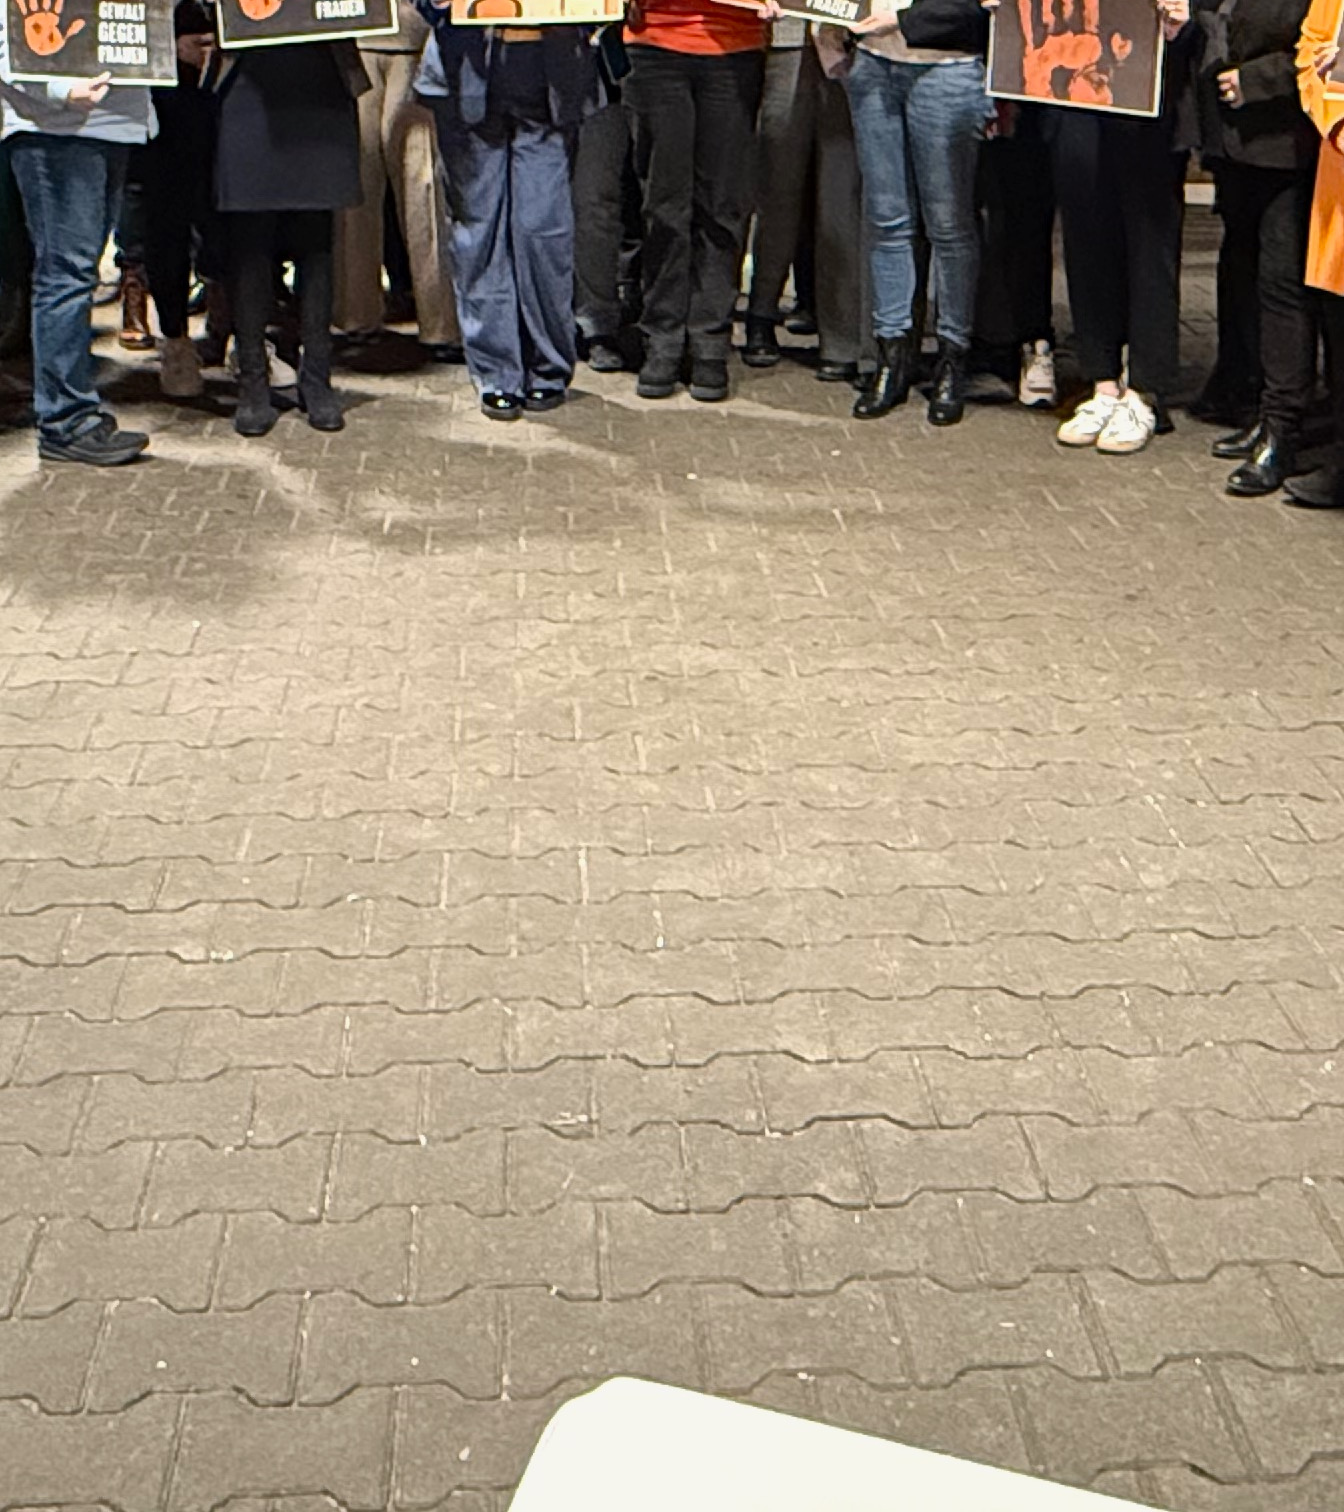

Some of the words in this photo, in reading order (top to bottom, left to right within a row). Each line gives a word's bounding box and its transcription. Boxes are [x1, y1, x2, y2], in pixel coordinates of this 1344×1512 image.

[98, 1, 146, 21] GEWALT
[316, 0, 366, 20] FRAUEN
[98, 21, 146, 45] GEGEN
[97, 44, 148, 65] FRAUEN
